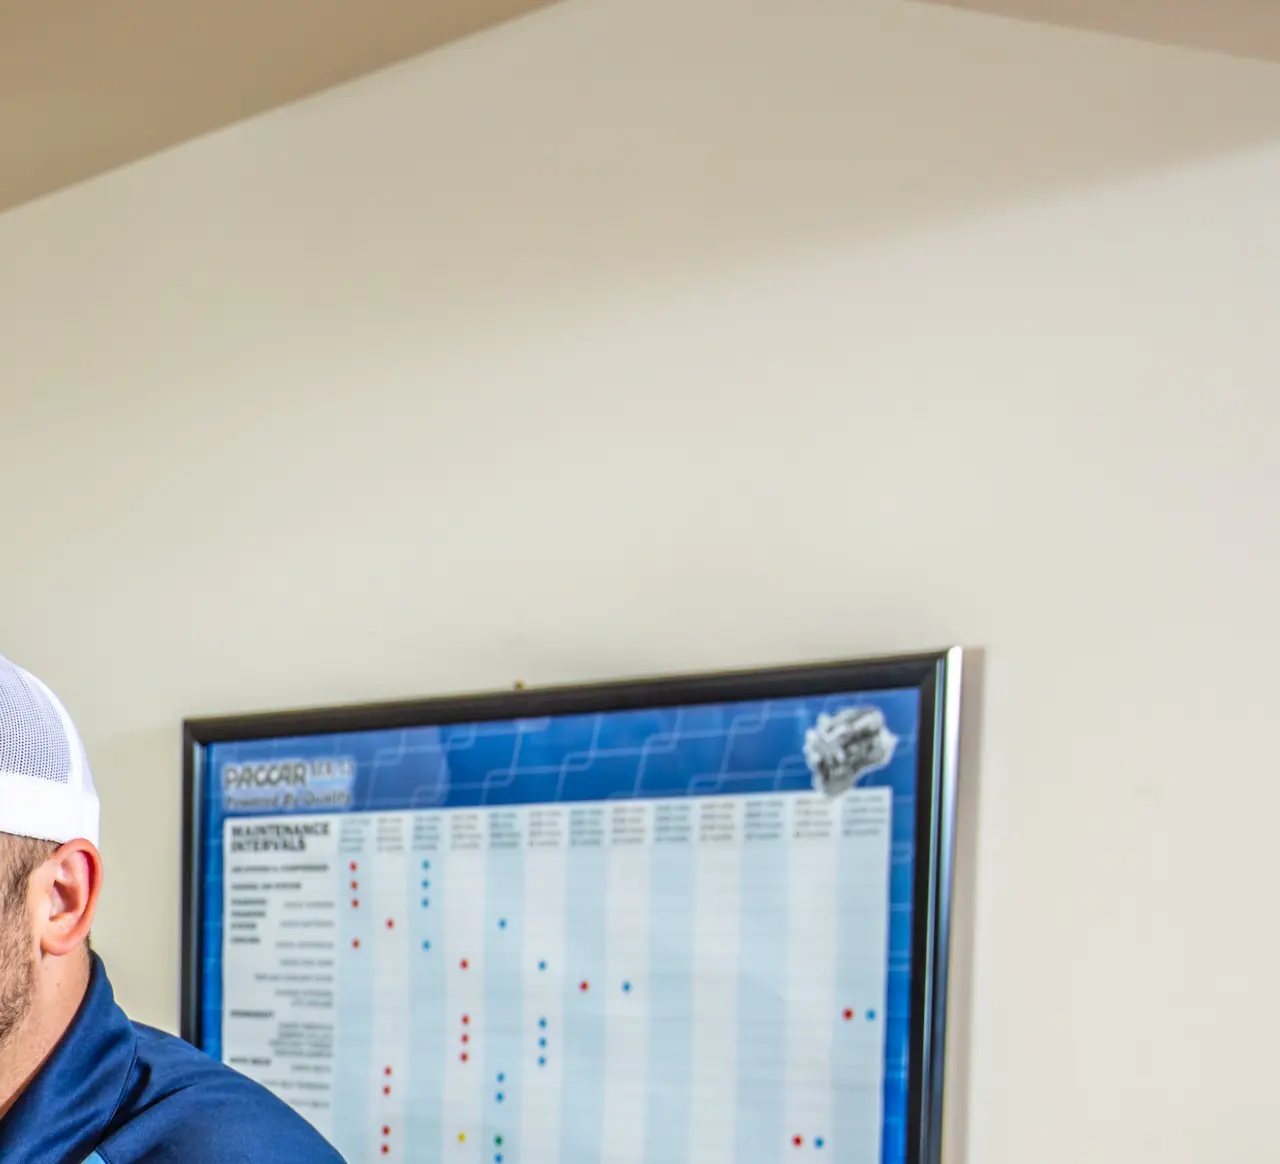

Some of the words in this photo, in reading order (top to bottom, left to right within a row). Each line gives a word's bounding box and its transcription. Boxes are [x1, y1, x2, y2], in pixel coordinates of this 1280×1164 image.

[225, 762, 307, 789] PACCAR
[231, 823, 330, 838] MAINTENANCE
[231, 838, 307, 853] INTERVALS
